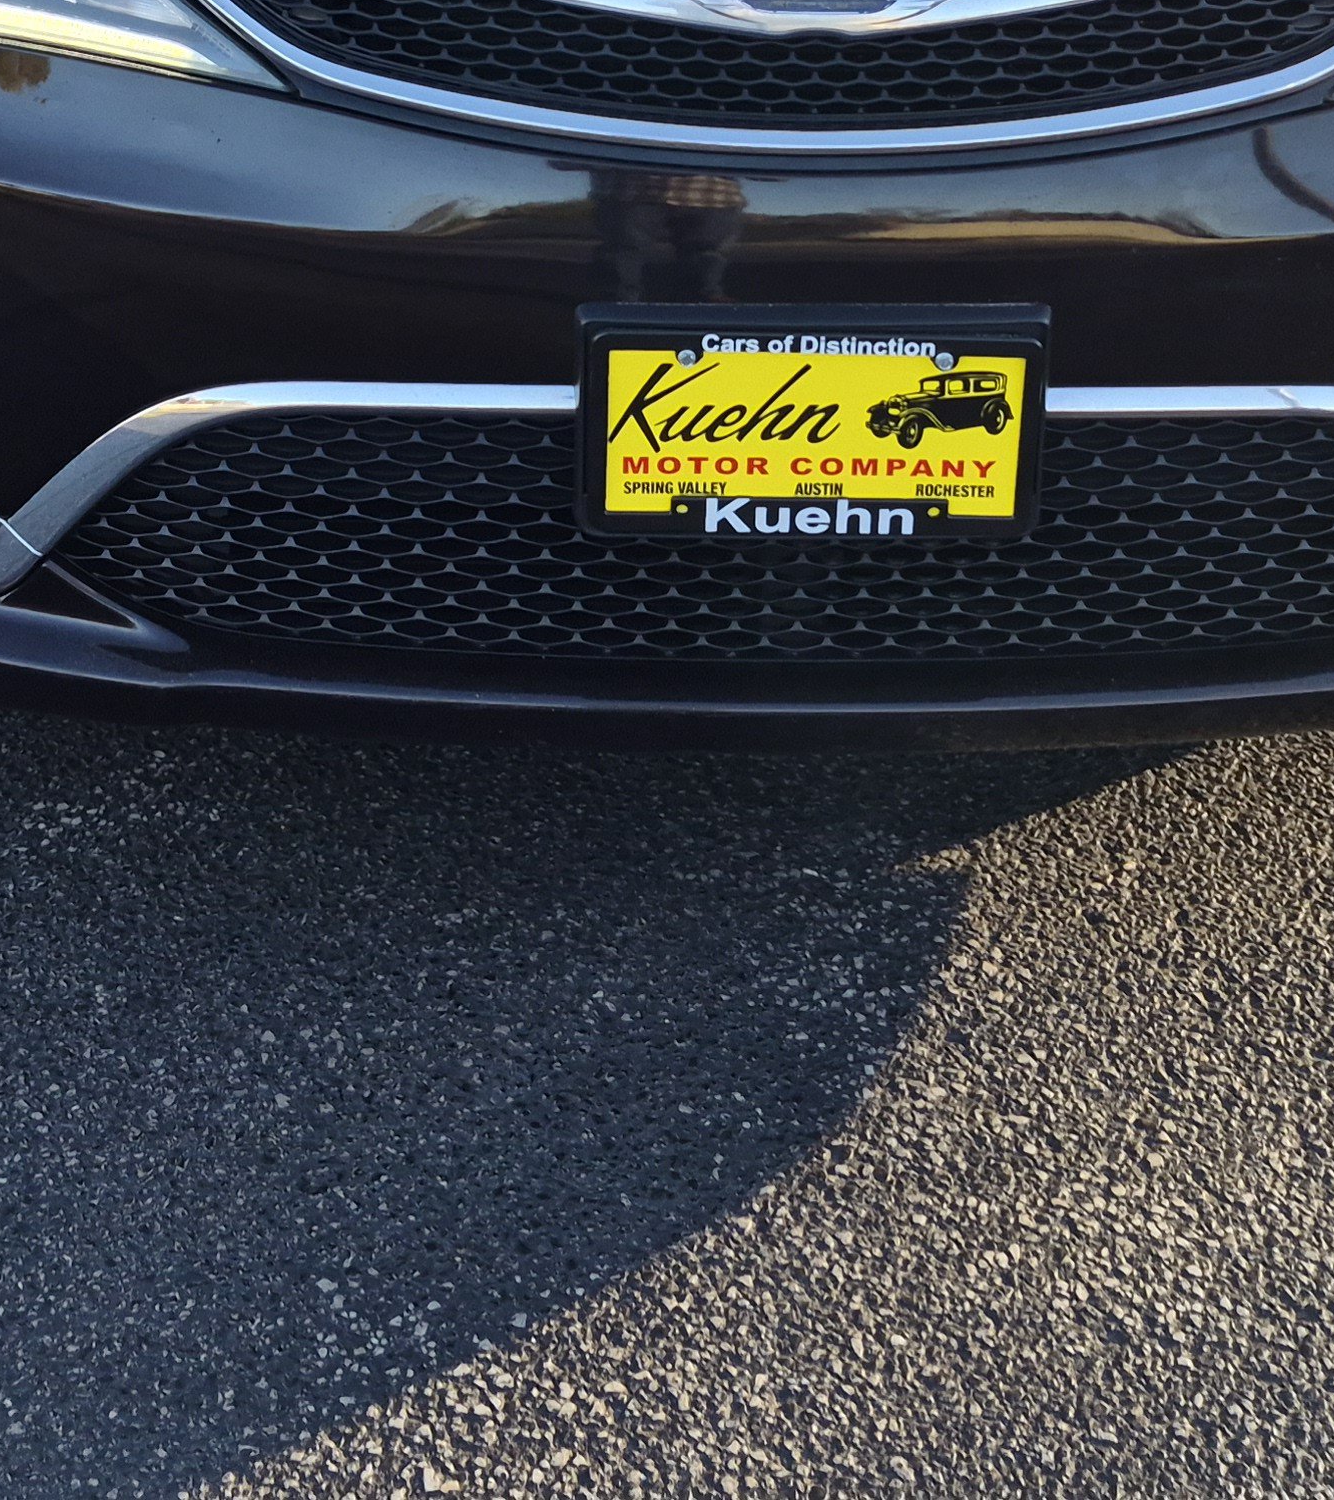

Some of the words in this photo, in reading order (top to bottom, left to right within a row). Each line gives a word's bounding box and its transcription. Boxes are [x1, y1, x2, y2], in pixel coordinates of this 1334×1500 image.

[701, 333, 760, 353] Cars
[768, 335, 795, 353] of
[799, 335, 936, 357] Distinction
[608, 362, 841, 453] Kuehn
[622, 456, 769, 475] MOTOR
[790, 457, 997, 478] COMPANY
[623, 481, 674, 494] SPRING
[678, 482, 727, 495] VALLEY
[795, 483, 844, 496] AUSTIN
[916, 485, 995, 498] ROCHESTER
[704, 498, 914, 535] Kuehn
